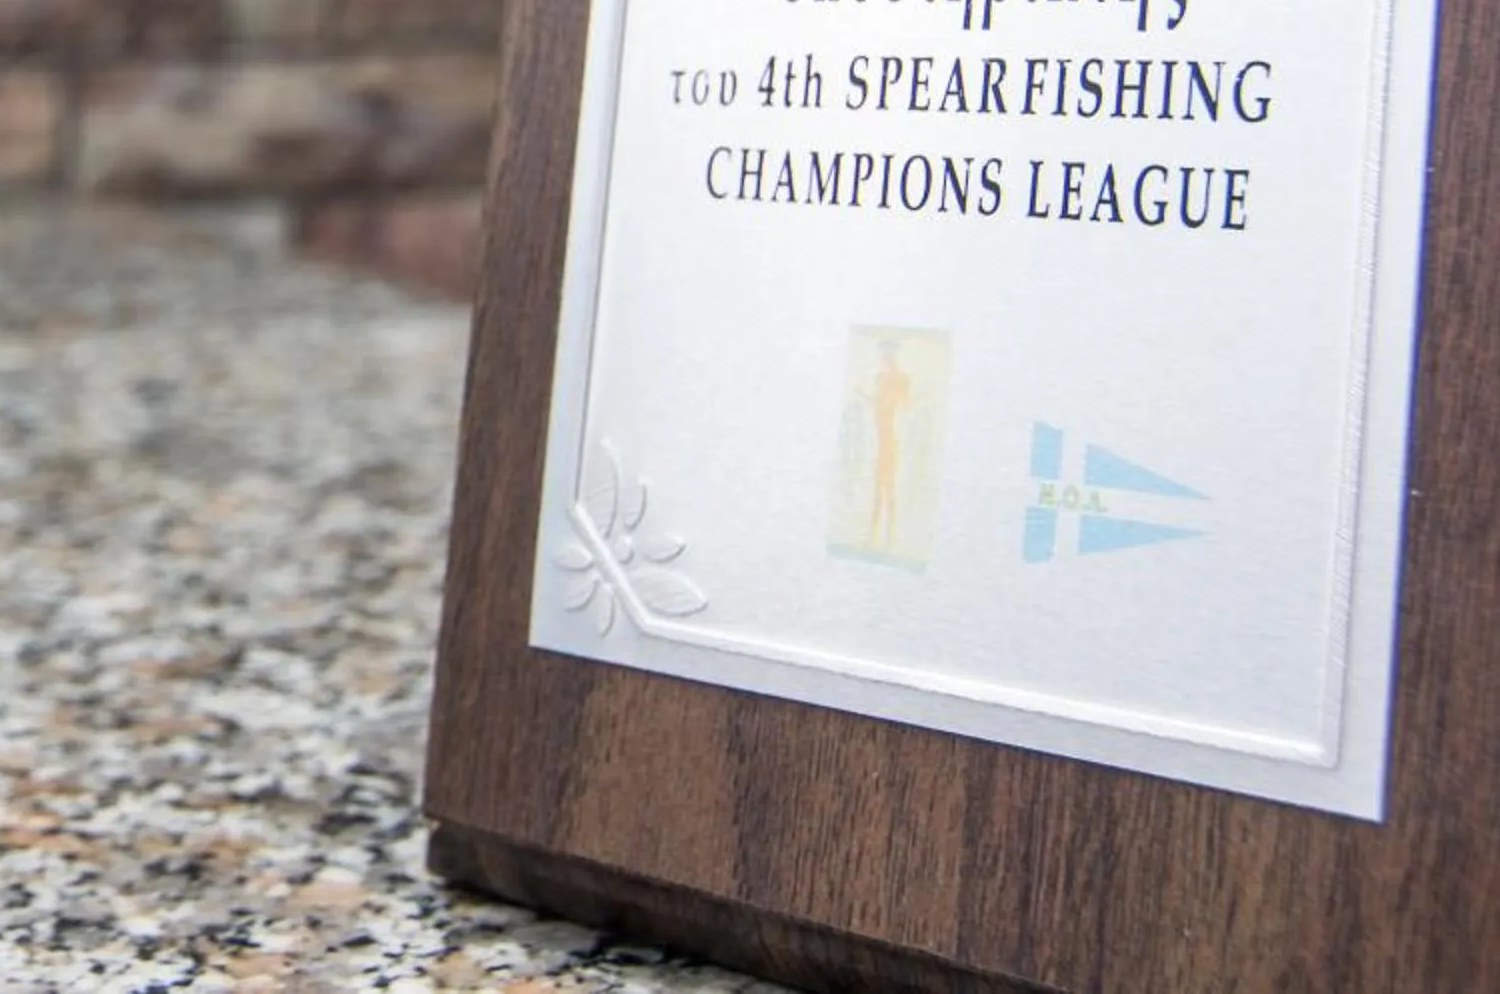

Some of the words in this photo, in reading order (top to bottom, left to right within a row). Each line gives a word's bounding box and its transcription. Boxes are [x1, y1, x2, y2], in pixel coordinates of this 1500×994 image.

[757, 52, 823, 109] 4th
[705, 145, 1003, 216] CHAMPIONS
[1025, 159, 1251, 232] LEAGUE
